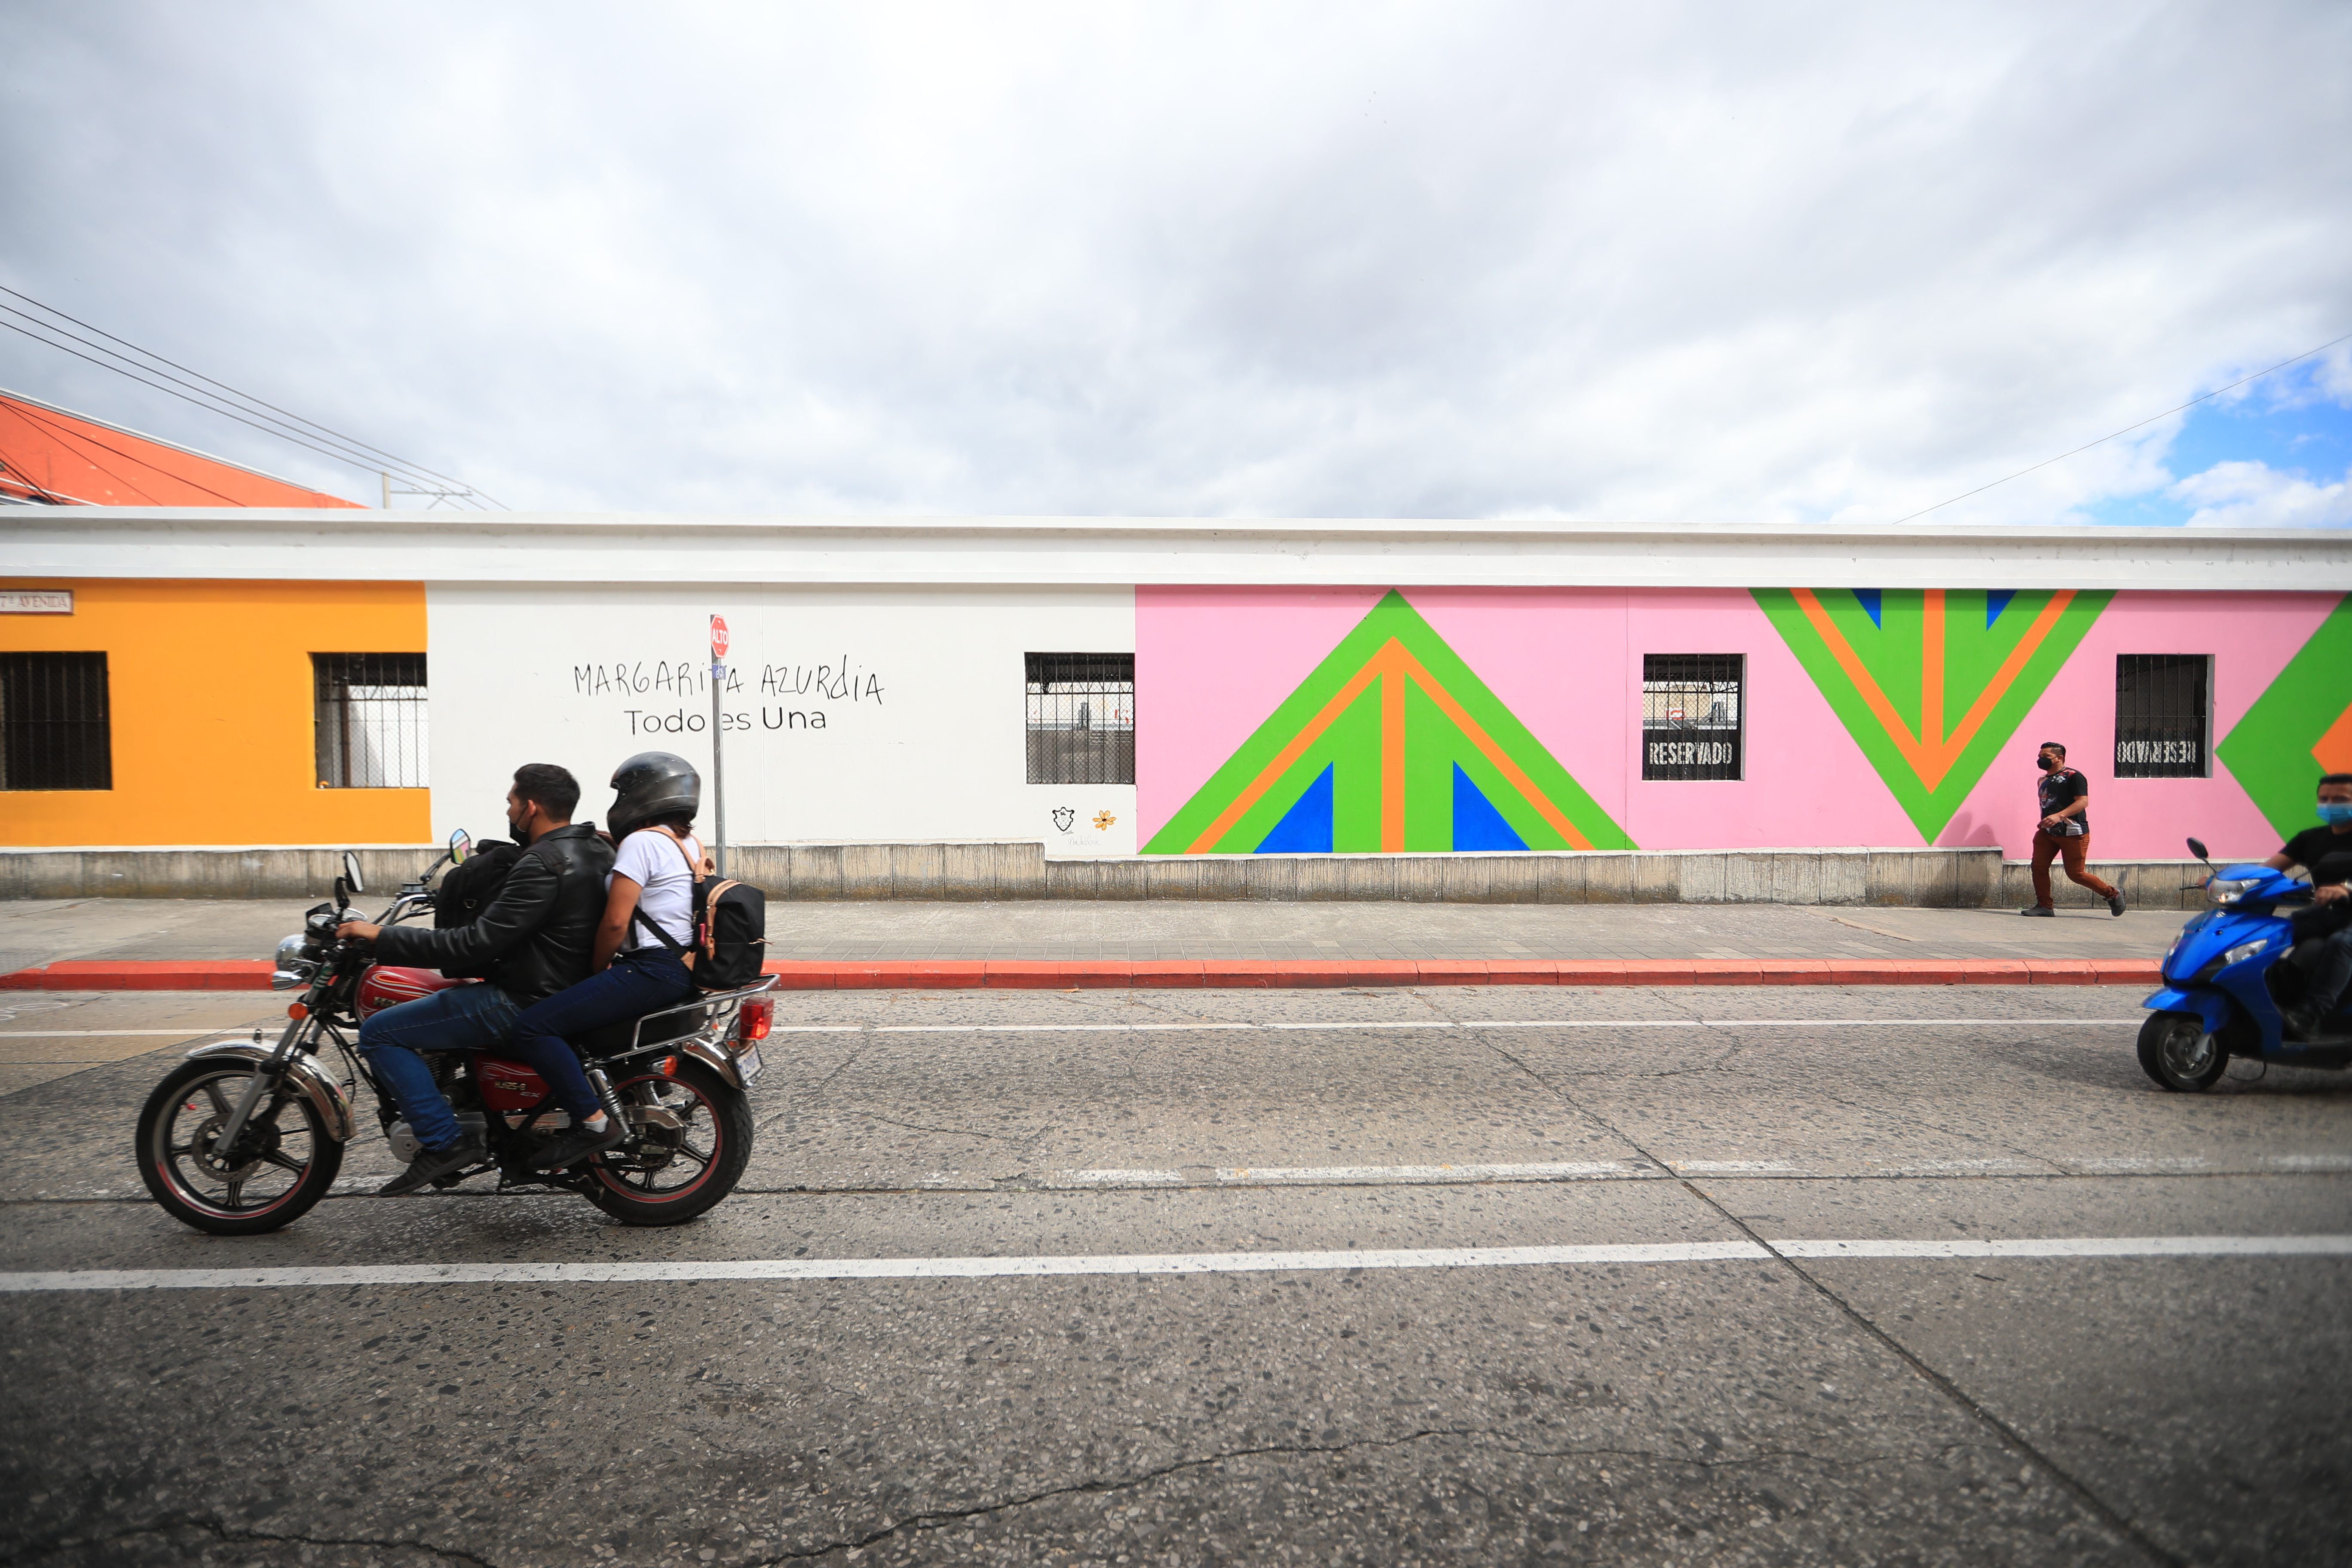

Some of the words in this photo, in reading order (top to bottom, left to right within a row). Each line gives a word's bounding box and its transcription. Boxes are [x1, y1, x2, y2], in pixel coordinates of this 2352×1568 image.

[17, 595, 69, 608] AVENIDA
[712, 628, 728, 646] ALTO
[624, 708, 705, 735] Todo
[722, 713, 751, 731] es
[763, 707, 826, 730] Una
[1649, 742, 1733, 765] RESERVADO
